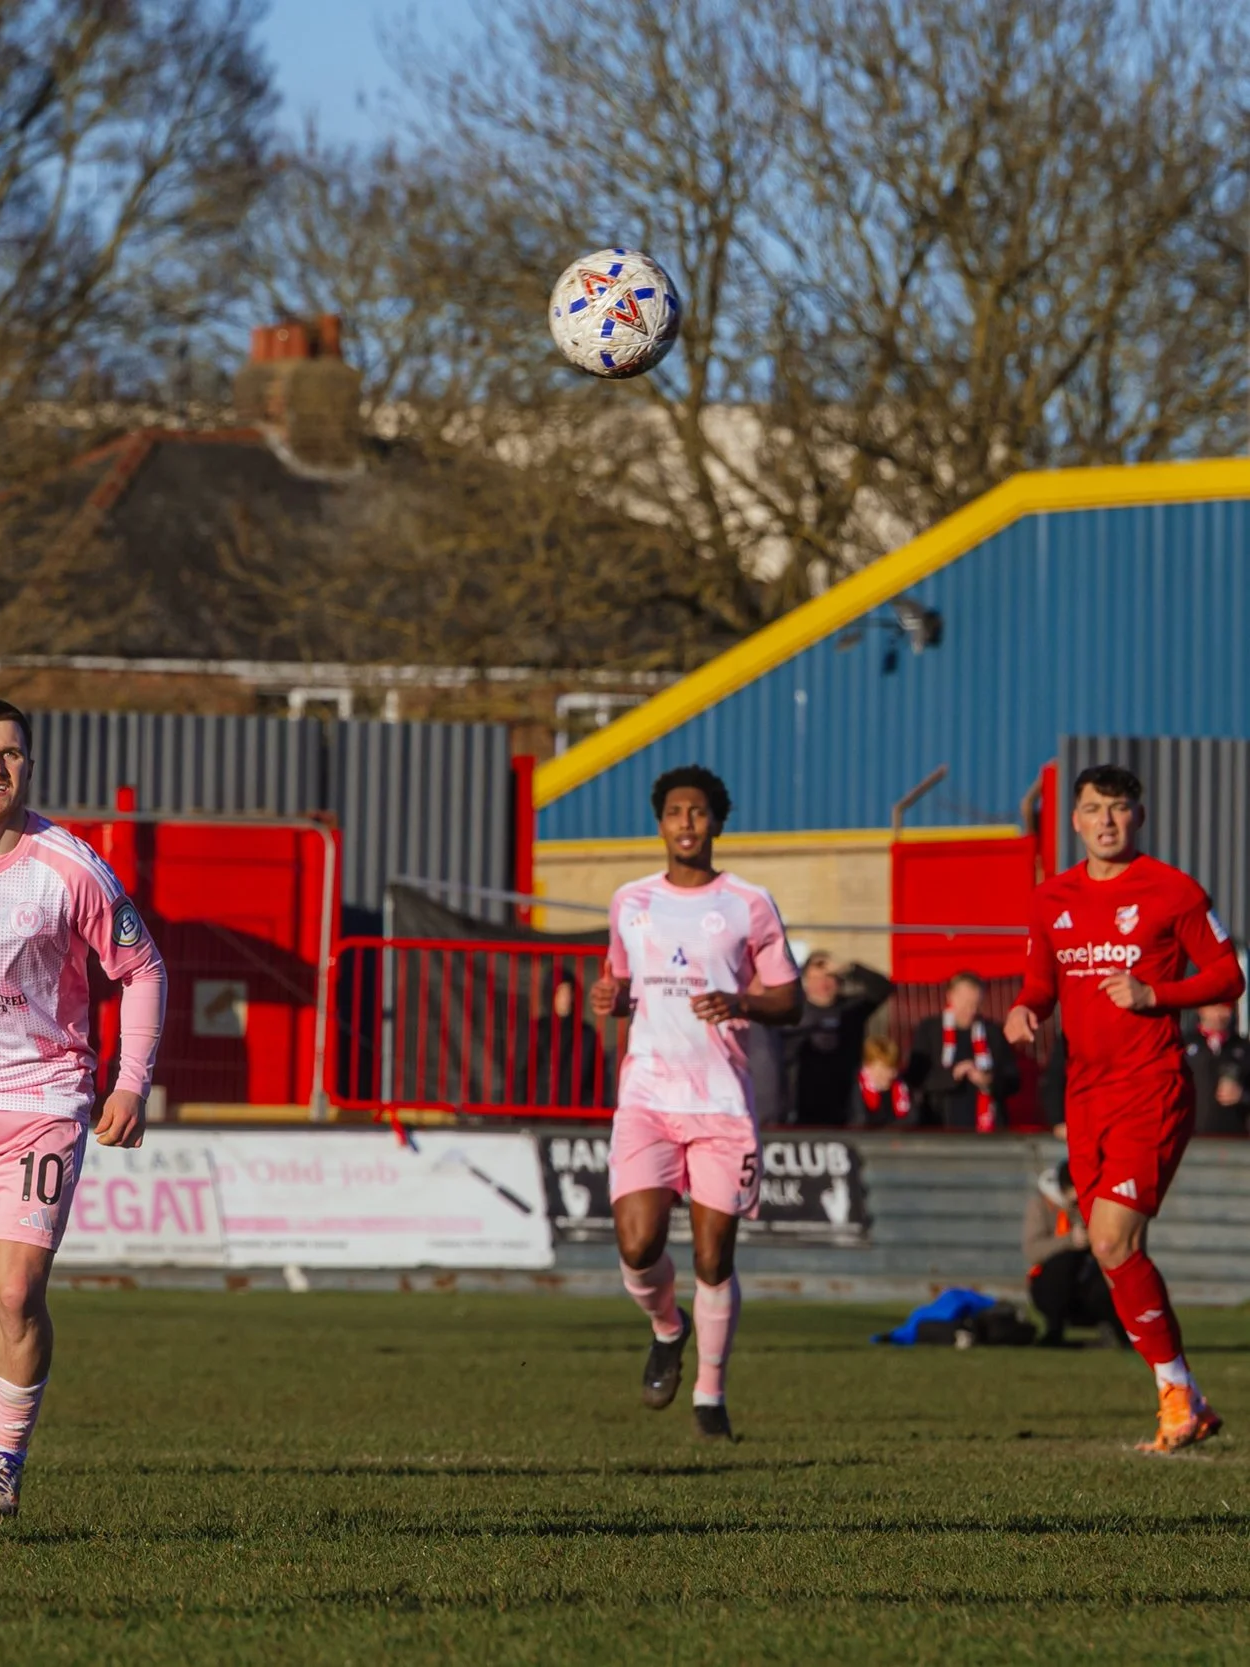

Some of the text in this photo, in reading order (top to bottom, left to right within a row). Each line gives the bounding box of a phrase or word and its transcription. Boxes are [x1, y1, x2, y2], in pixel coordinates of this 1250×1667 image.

[740, 1152, 758, 1188] 5
[763, 1142, 851, 1177] CLUB
[20, 1151, 64, 1205] 10
